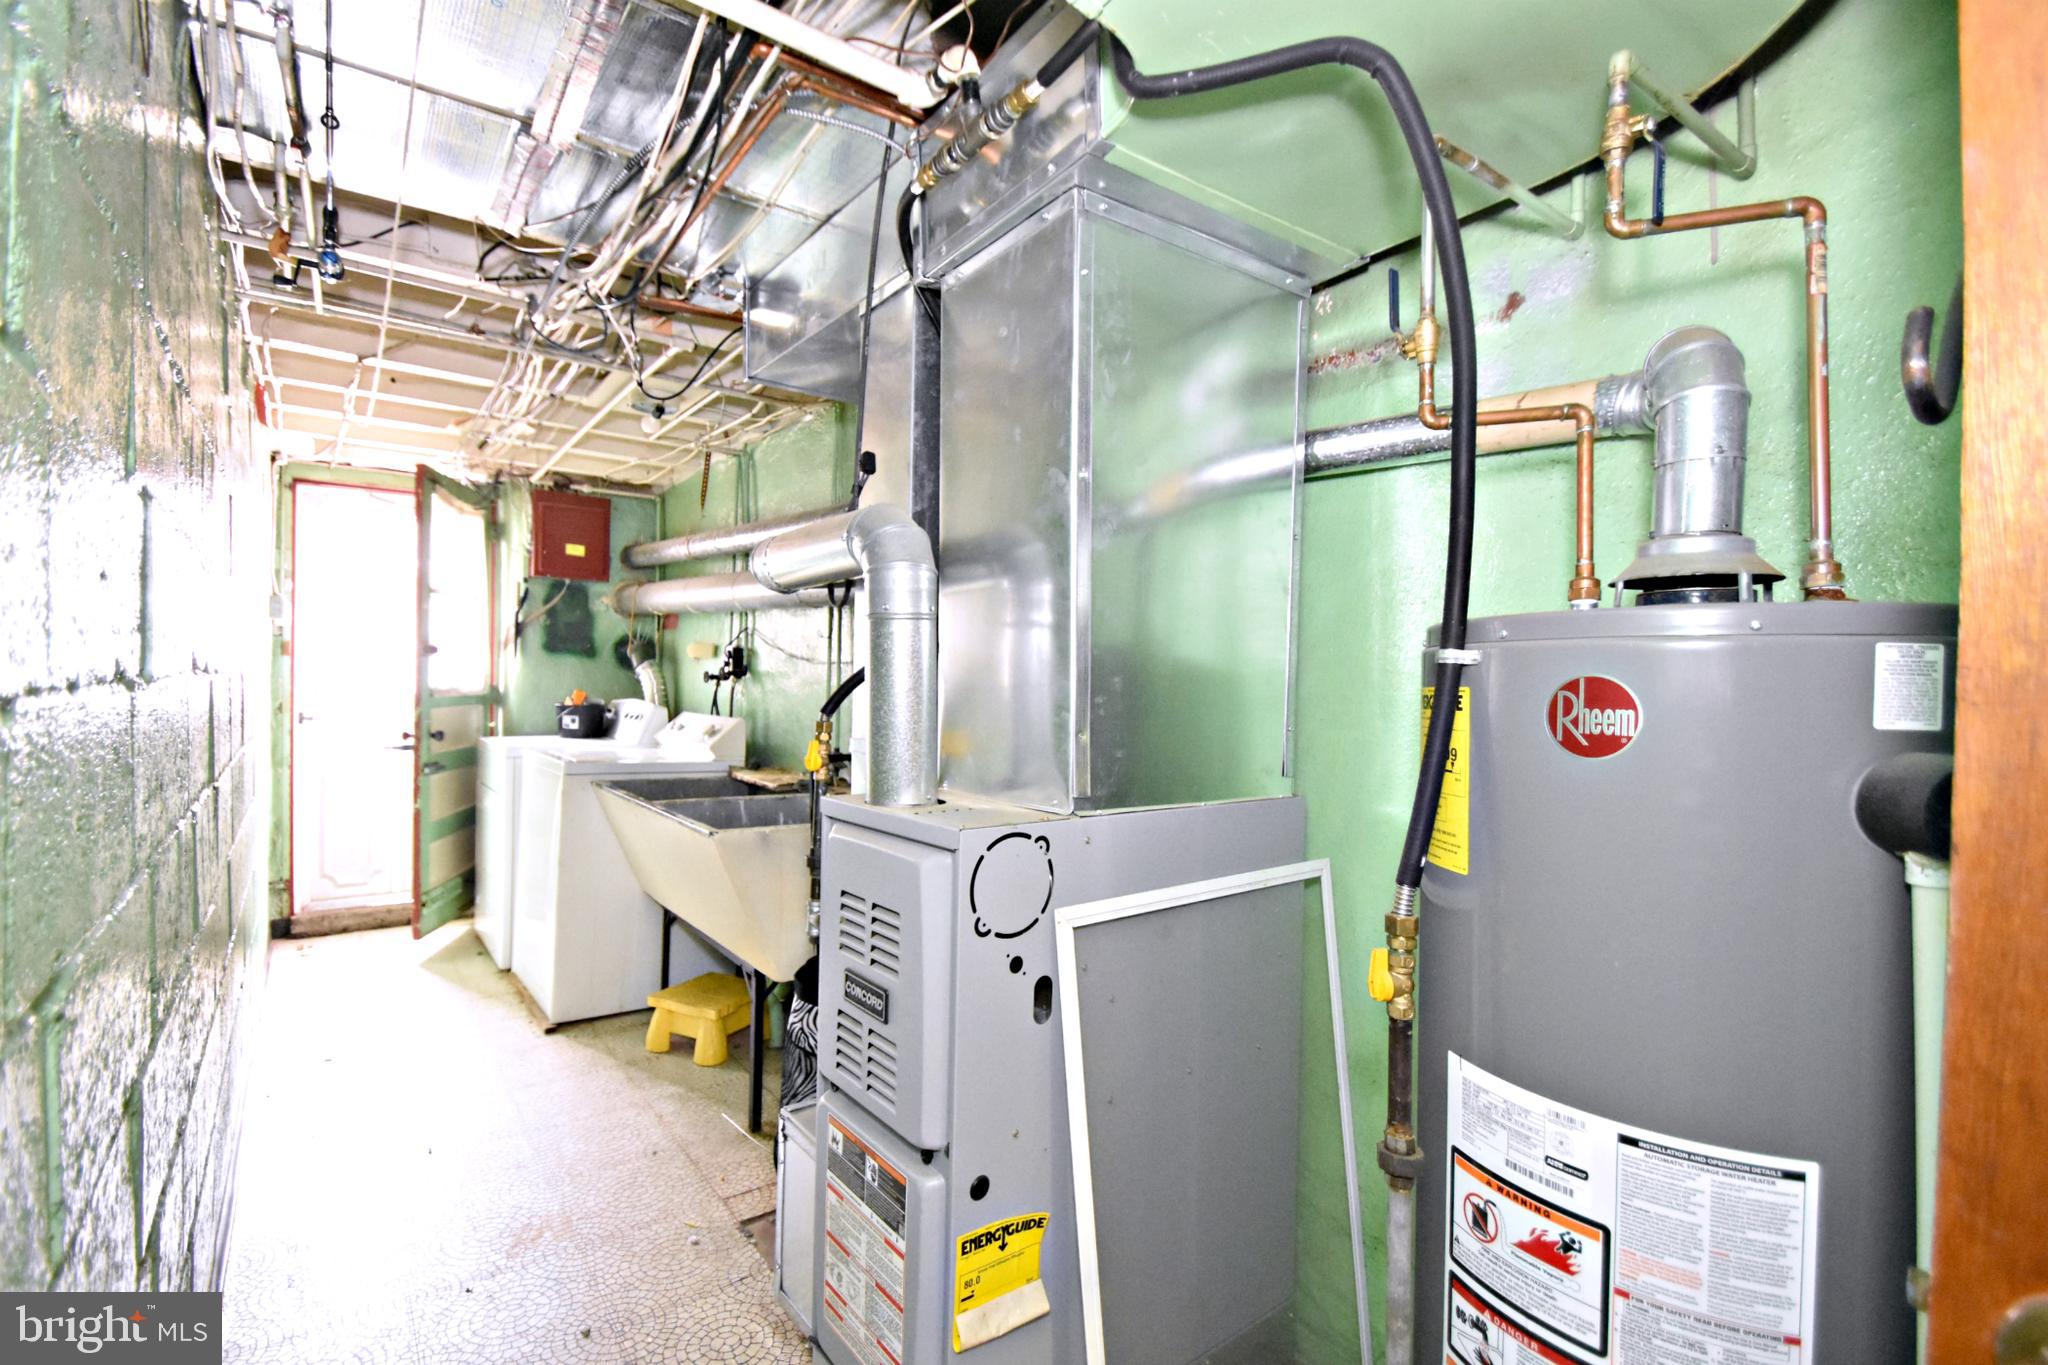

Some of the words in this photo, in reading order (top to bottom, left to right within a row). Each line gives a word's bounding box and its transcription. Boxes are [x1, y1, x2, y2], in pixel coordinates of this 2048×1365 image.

[1557, 677, 1634, 746] Rheem
[846, 981, 883, 1010] CONCORD
[1638, 1141, 1688, 1159] INSTALLATION
[1690, 1153, 1706, 1163] AND
[1707, 1158, 1750, 1172] OPERATION
[1751, 1166, 1783, 1178] DETAILS
[1643, 1152, 1685, 1169] AUTOMATIC
[1687, 1162, 1722, 1176] STORAGE
[1722, 1170, 1747, 1182] WATER
[1747, 1176, 1776, 1187] HEATER
[1496, 1185, 1551, 1219] WARNING
[961, 1217, 1047, 1256] ENERGYGUIDE
[963, 1275, 981, 1290] 80.0
[1631, 1295, 1645, 1305] FOR
[1646, 1301, 1664, 1311] YOUR
[1665, 1307, 1692, 1320] SAFETY
[1693, 1314, 1712, 1327] READ
[1713, 1320, 1741, 1334] BEFORE
[1493, 1319, 1539, 1351] DANGER
